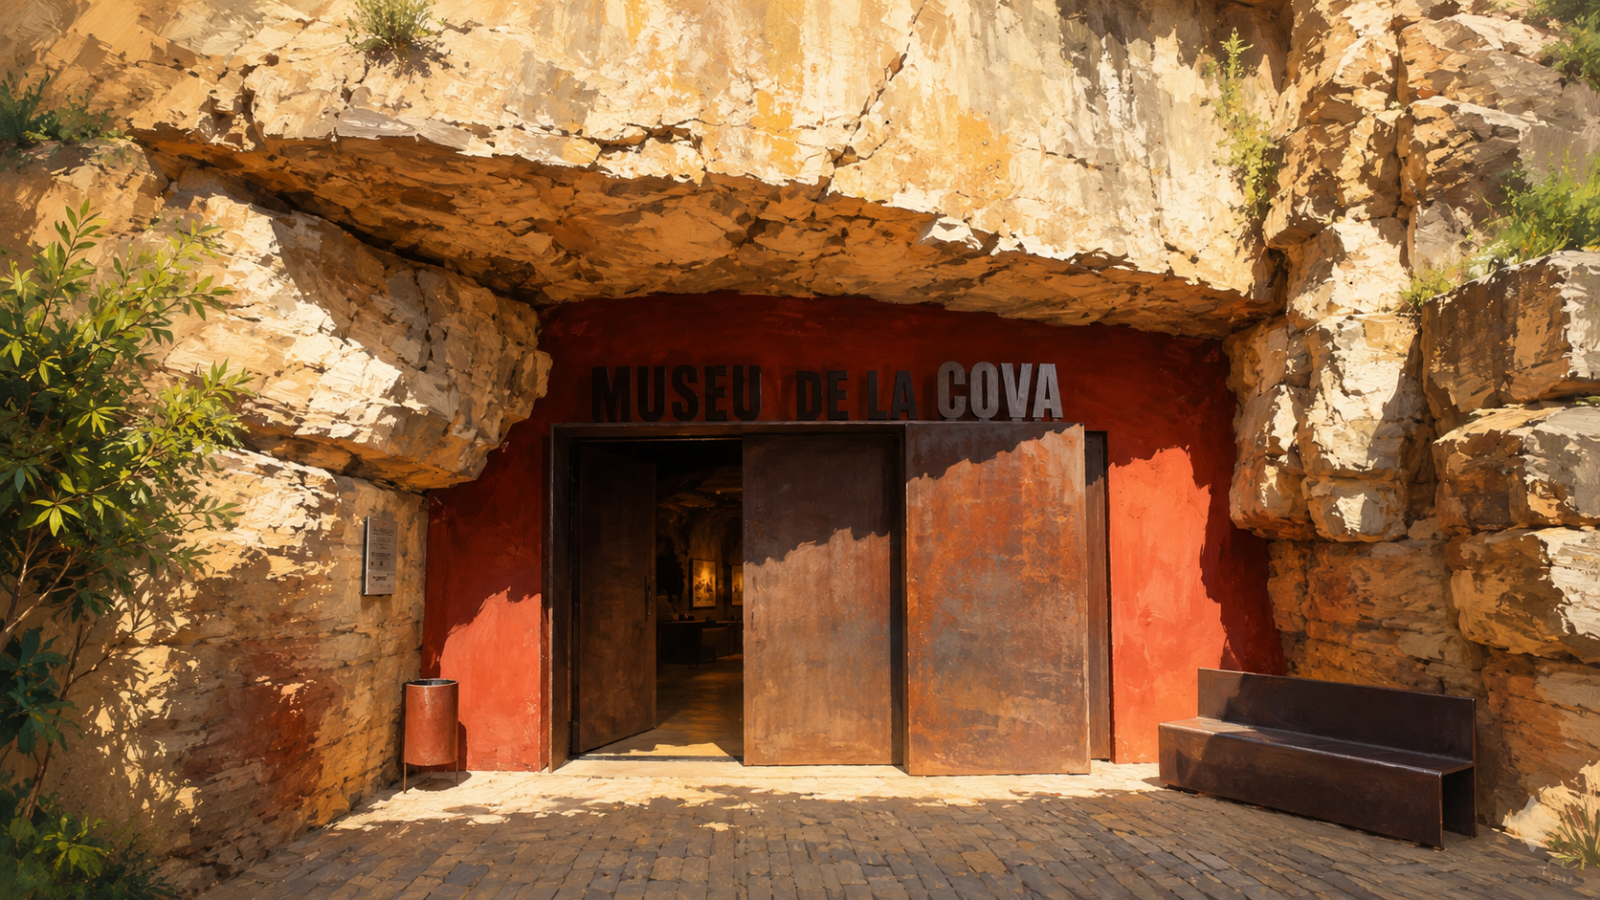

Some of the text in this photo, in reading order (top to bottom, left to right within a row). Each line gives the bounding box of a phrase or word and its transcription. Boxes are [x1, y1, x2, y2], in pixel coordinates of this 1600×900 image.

[591, 361, 1063, 422] MUSEU DE LA COVA
